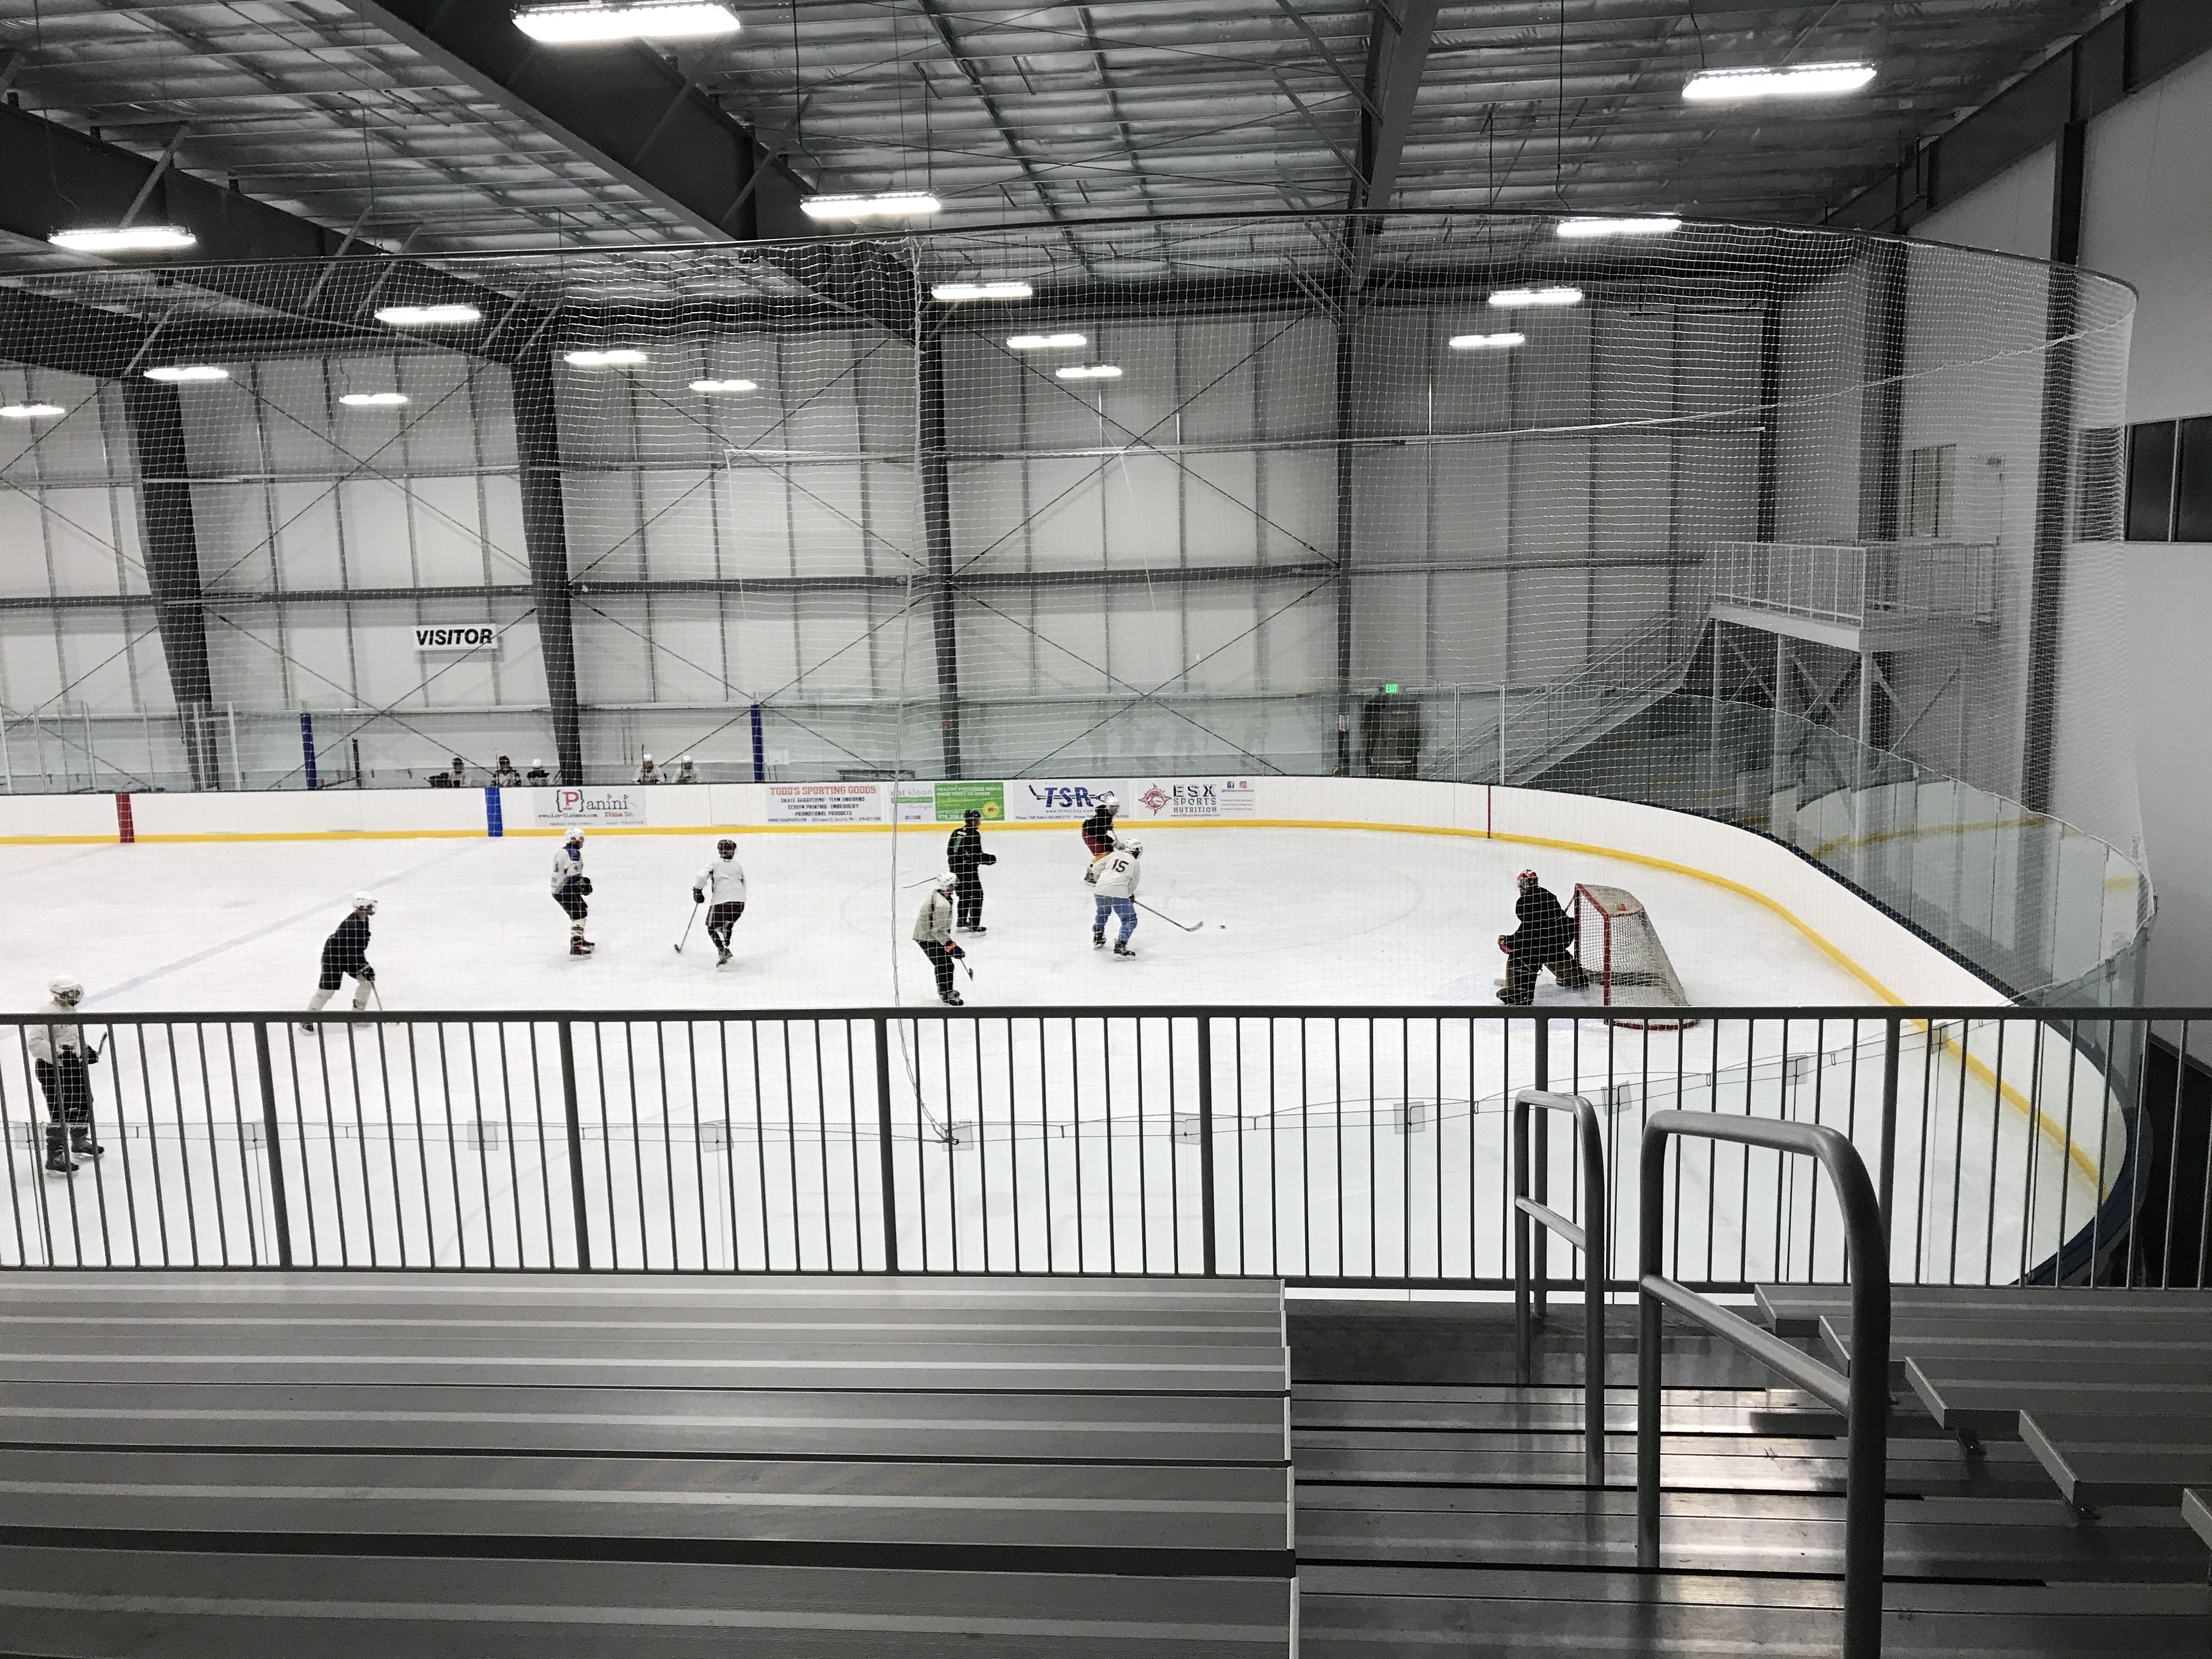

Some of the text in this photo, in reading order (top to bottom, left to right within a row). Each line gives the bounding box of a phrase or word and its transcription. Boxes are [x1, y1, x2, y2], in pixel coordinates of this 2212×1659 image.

[416, 629, 493, 645] VISITOR
[1386, 684, 1397, 693] EXIT
[770, 786, 876, 795] TODD'S SPORTING GOODS
[1045, 787, 1093, 807] TSR
[1173, 784, 1217, 797] ESX
[1112, 859, 1129, 873] 15
